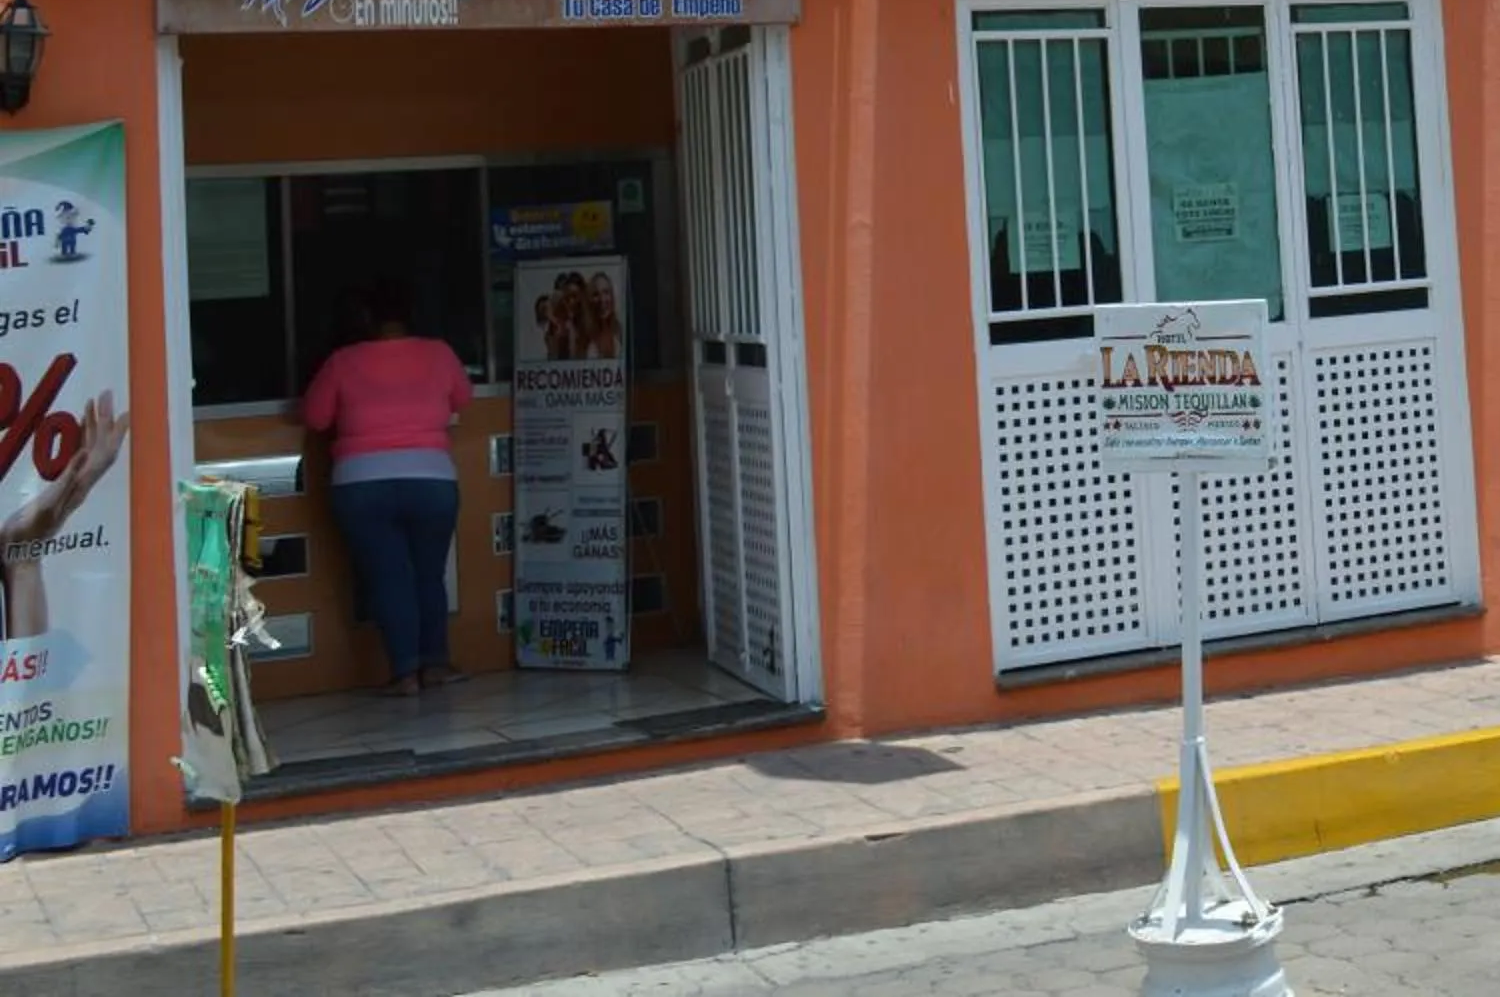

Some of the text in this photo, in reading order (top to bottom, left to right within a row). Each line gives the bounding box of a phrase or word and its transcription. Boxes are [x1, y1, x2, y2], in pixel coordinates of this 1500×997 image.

[54, 298, 80, 325] el
[516, 367, 625, 391] RECOMIENDA
[7, 525, 110, 559] mensual.
